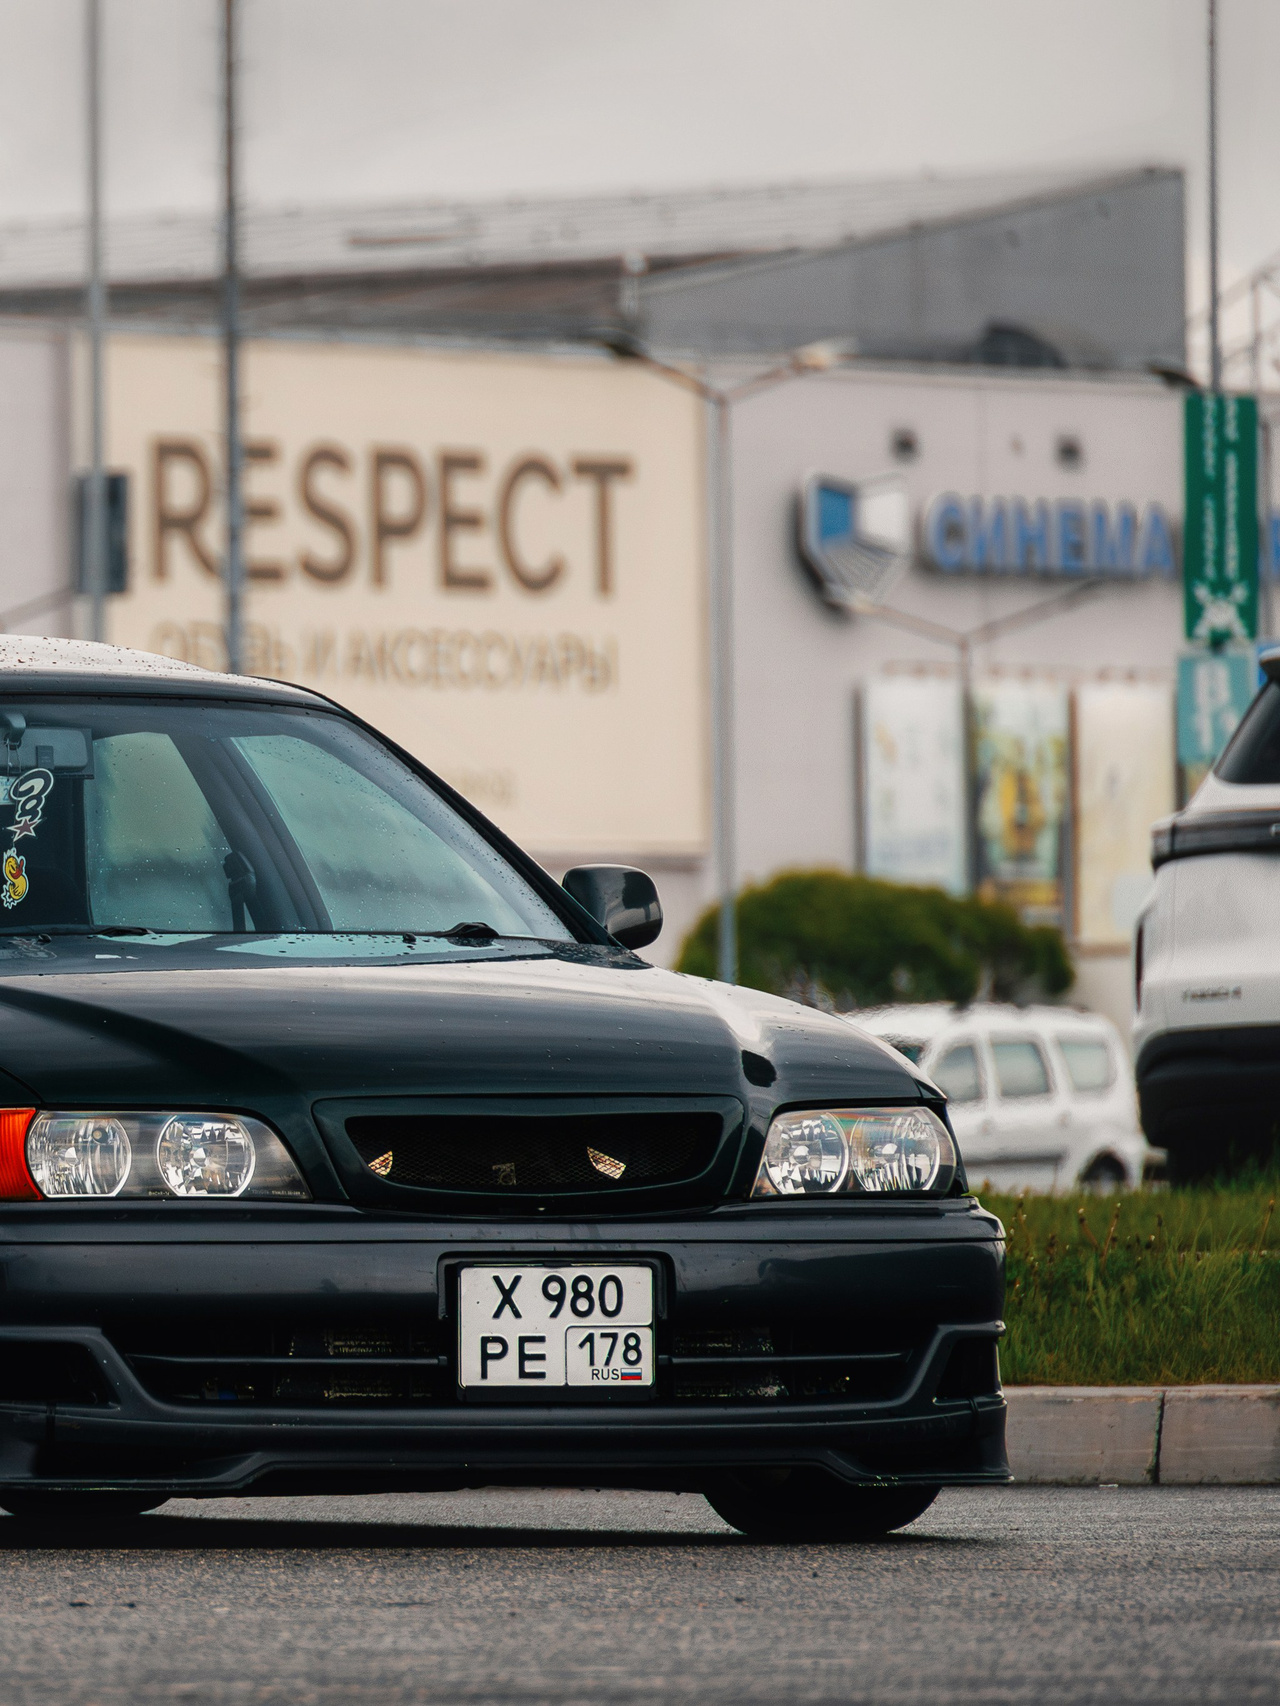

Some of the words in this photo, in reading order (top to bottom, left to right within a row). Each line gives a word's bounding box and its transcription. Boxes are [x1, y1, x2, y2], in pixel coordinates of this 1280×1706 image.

[151, 434, 633, 598] RESPECT
[925, 492, 1176, 575] СИНЕМА
[541, 1274, 624, 1319] 980
[578, 1332, 643, 1367] 178
[591, 1368, 620, 1381] RUS
